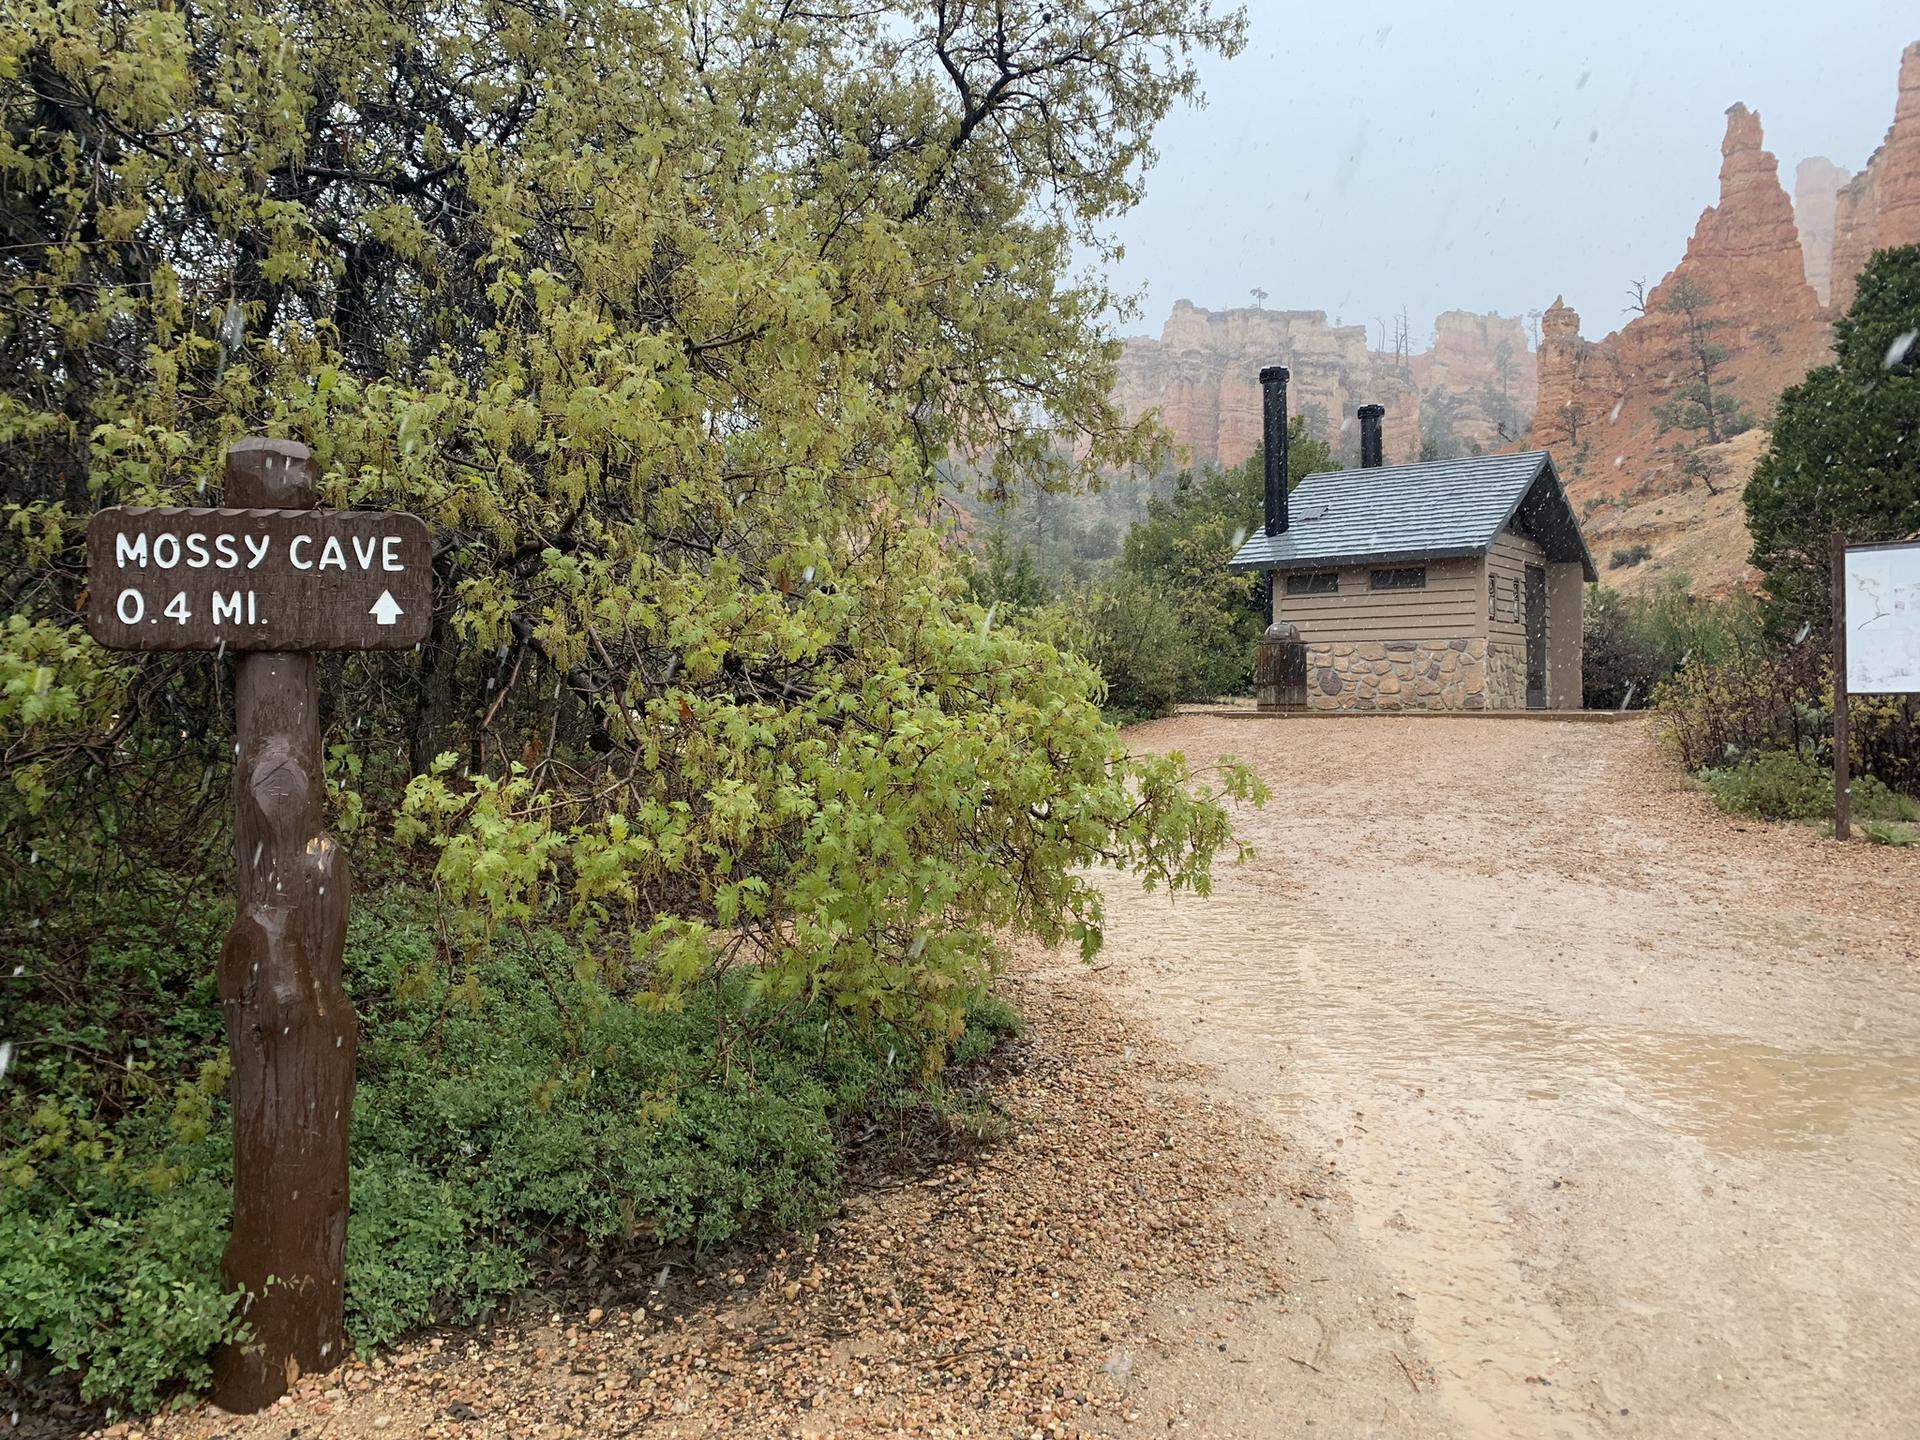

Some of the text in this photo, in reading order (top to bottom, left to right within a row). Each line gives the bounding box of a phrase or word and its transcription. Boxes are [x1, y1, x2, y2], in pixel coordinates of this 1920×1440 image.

[116, 532, 405, 571] MOSSY CAVE
[116, 588, 269, 625] 0.4 MI.
